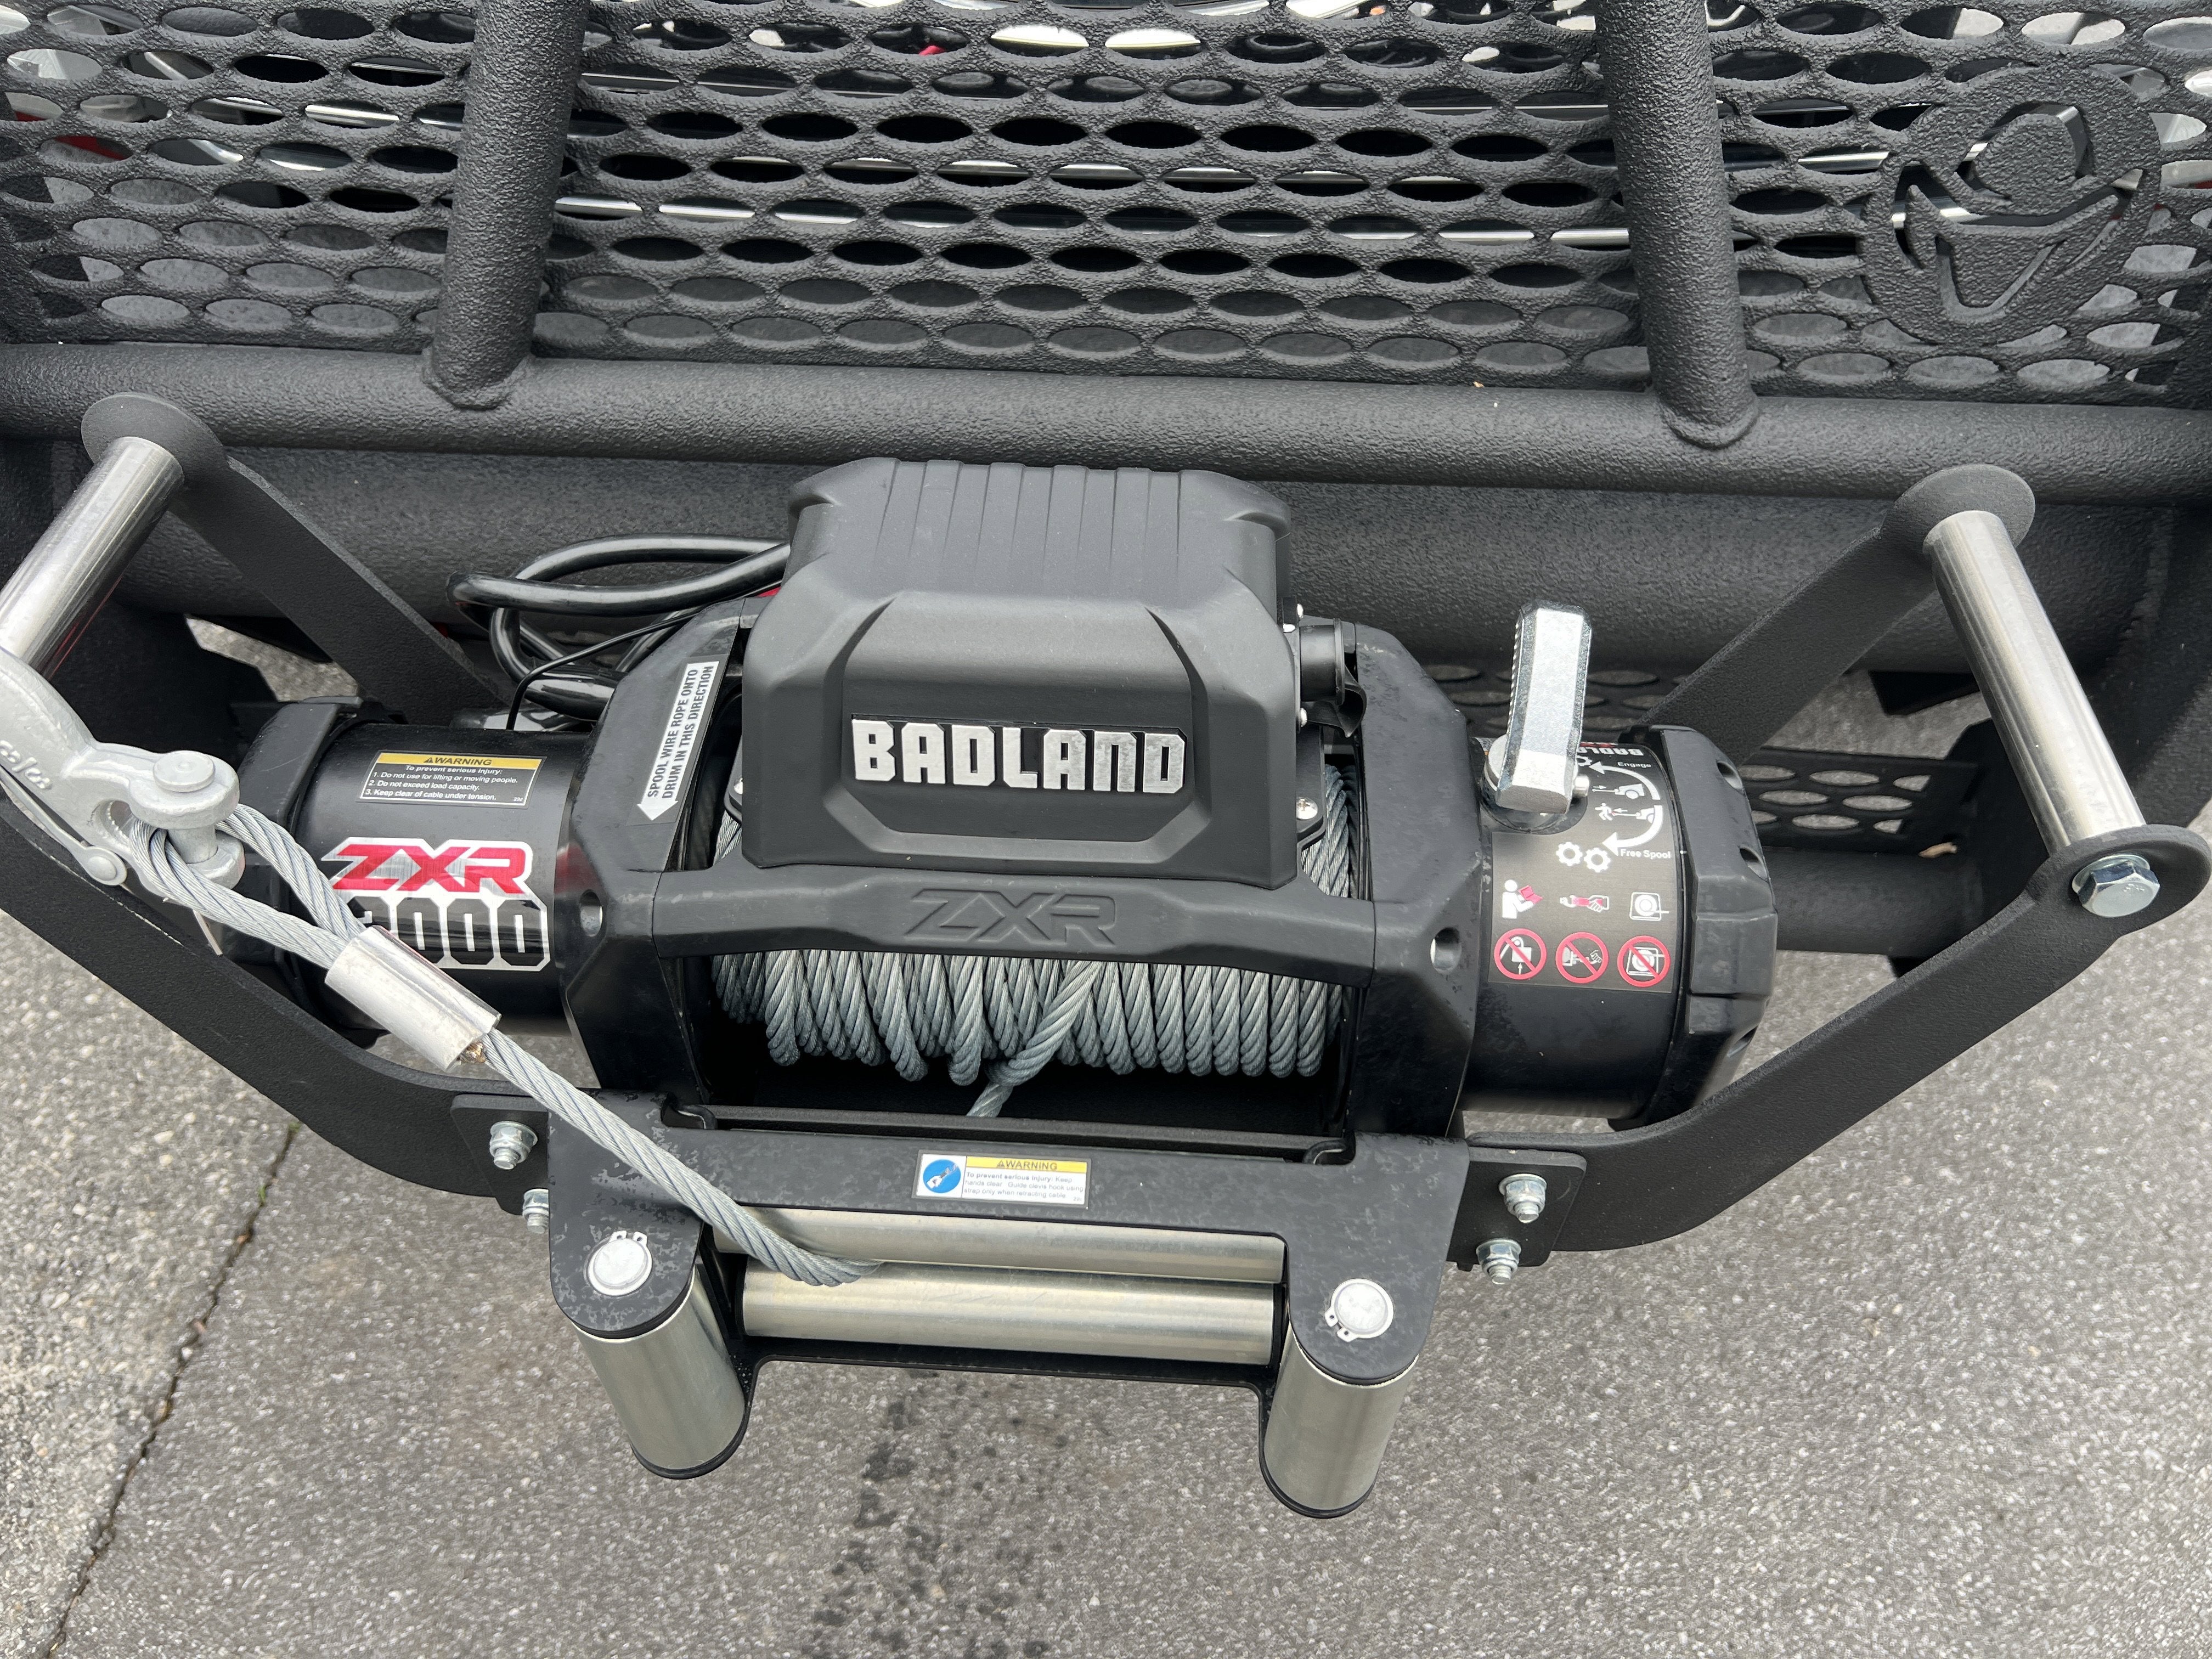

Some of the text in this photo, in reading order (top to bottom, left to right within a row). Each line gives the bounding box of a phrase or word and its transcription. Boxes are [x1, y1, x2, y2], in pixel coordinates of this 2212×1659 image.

[647, 669, 698, 798] SPOOL WIRE ROPE ONTO
[662, 666, 714, 799] DRUM IN THIS DIRECTION
[852, 718, 1186, 793] BADLAND
[1576, 747, 1644, 757] BADLA
[435, 757, 492, 765] WARNING
[374, 789, 394, 797] Keep
[1620, 849, 1671, 860] Free Spool
[332, 844, 526, 894] ZXR
[902, 888, 1116, 947] ZXR
[1006, 1160, 1058, 1170] WARNING
[1017, 1190, 1047, 1199] retracting
